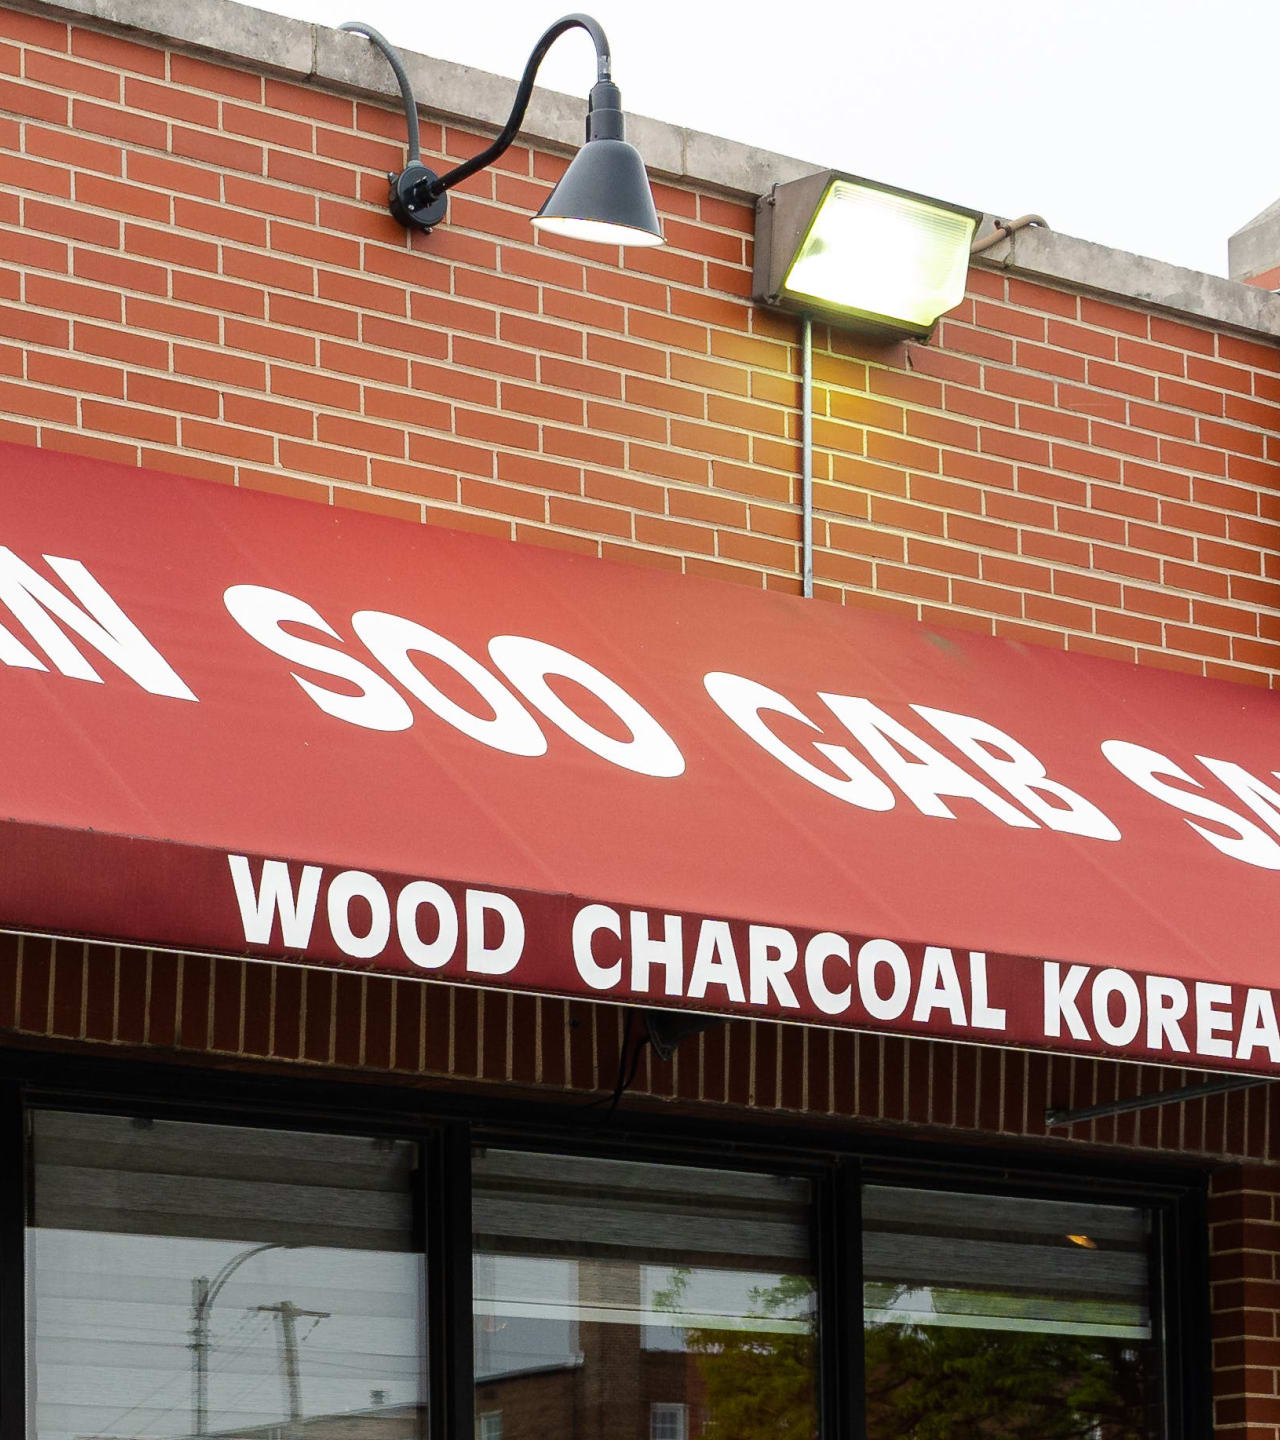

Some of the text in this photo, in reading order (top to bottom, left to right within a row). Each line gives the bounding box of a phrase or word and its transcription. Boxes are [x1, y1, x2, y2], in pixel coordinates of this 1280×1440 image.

[223, 584, 686, 778] SOO
[703, 671, 1122, 842] GAB
[227, 854, 525, 976] WOOD
[571, 903, 1007, 1031] CHARCOAL
